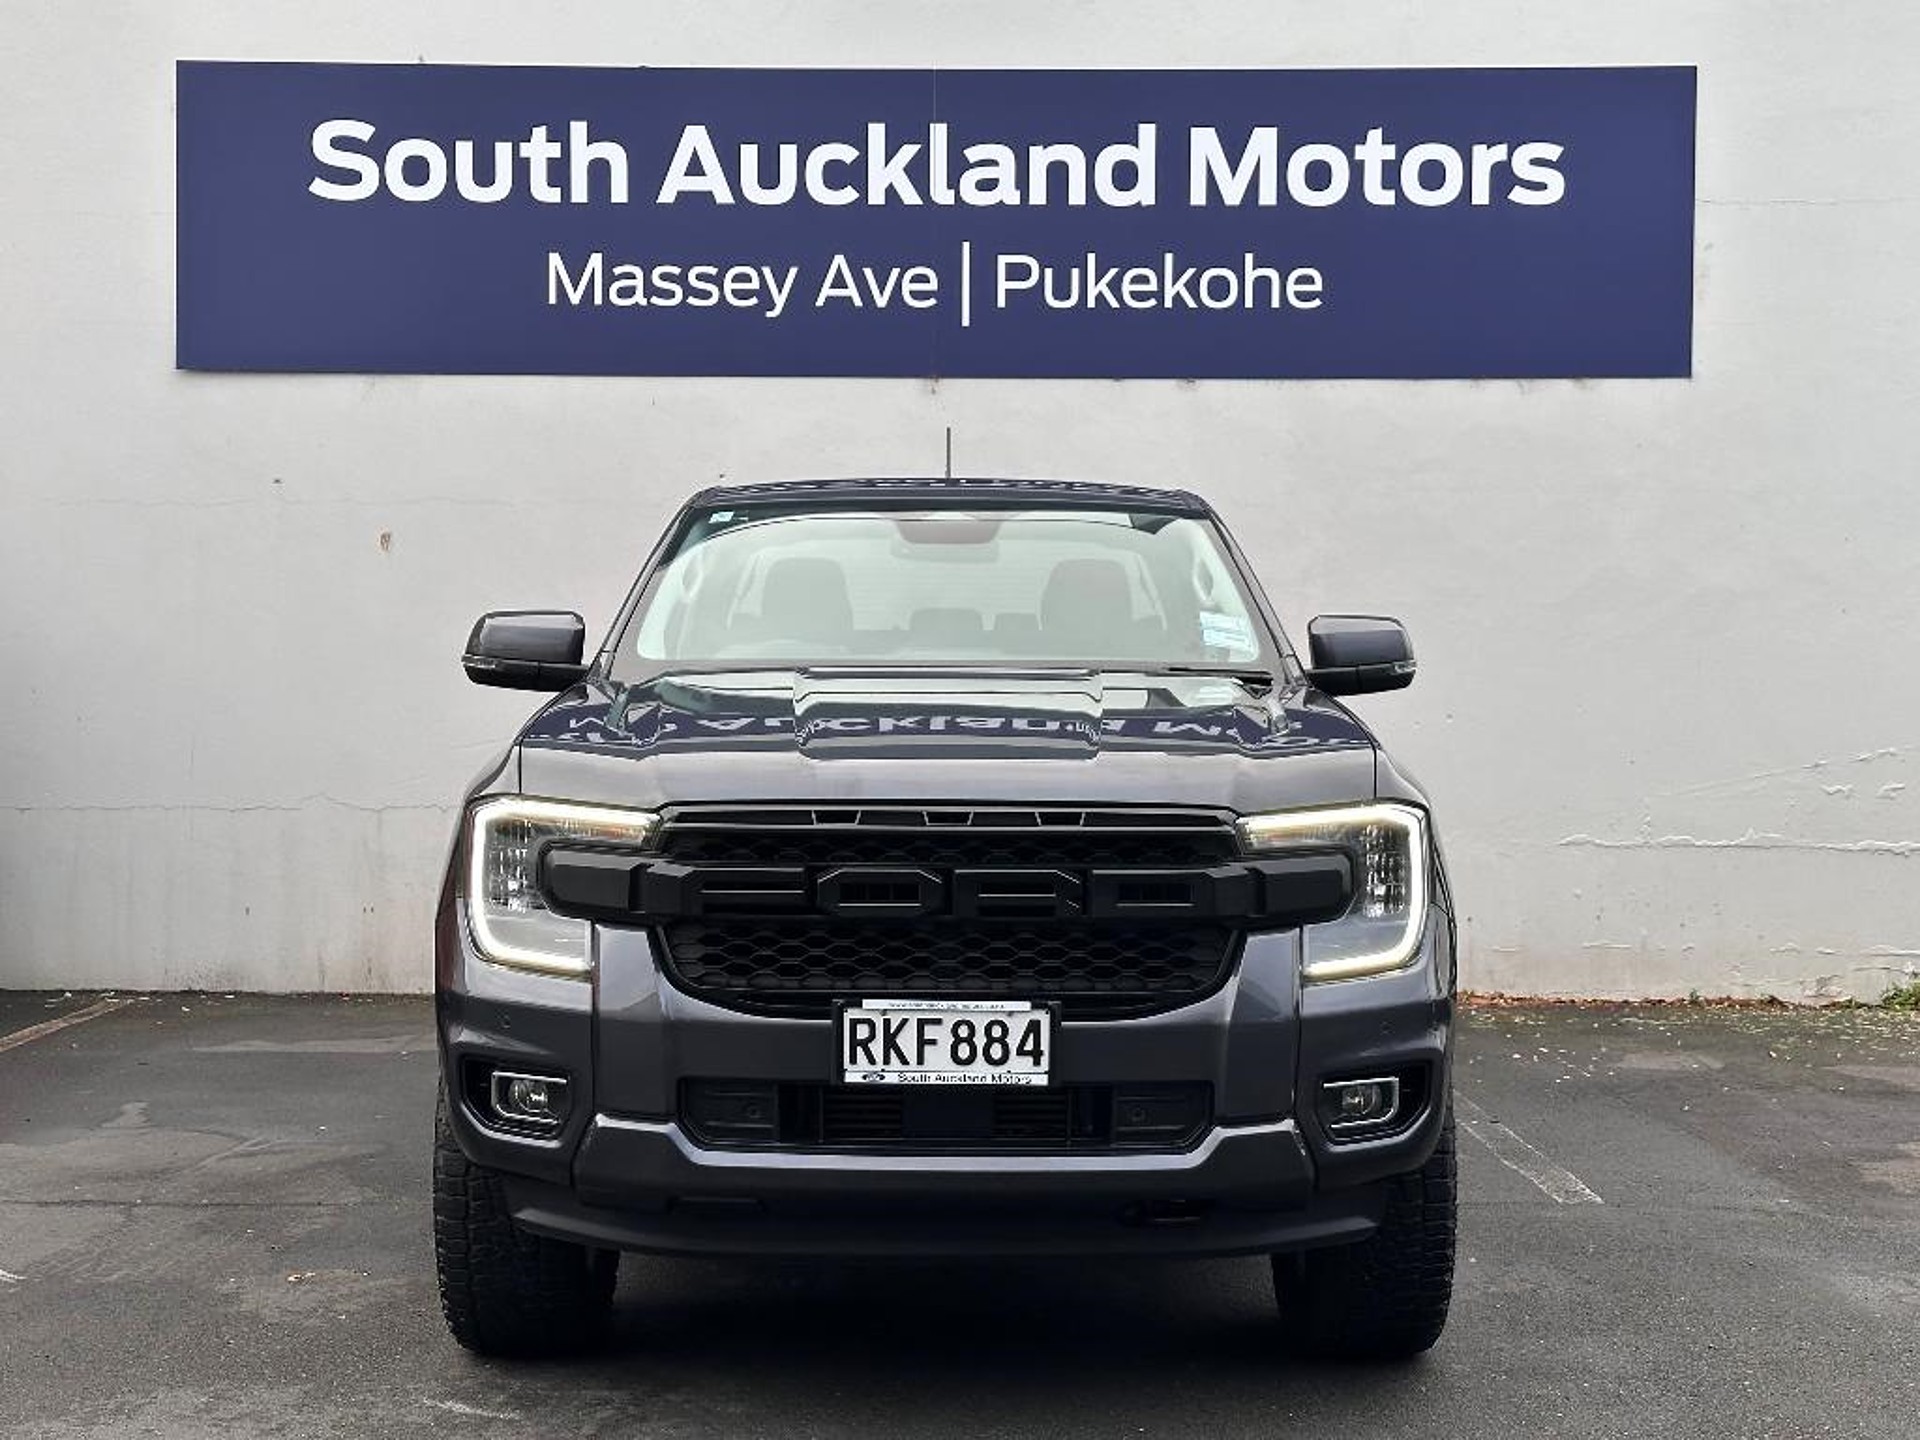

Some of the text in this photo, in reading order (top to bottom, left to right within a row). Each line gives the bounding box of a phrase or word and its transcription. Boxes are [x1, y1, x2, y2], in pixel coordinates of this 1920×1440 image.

[309, 120, 1565, 206] South Auckland Motors
[549, 253, 1322, 317] Massey Ave Pukekohe
[848, 1017, 1044, 1067] RKF884
[897, 1072, 931, 1083] South
[935, 1073, 987, 1083] Auckland
[991, 1073, 1032, 1085] Motors
